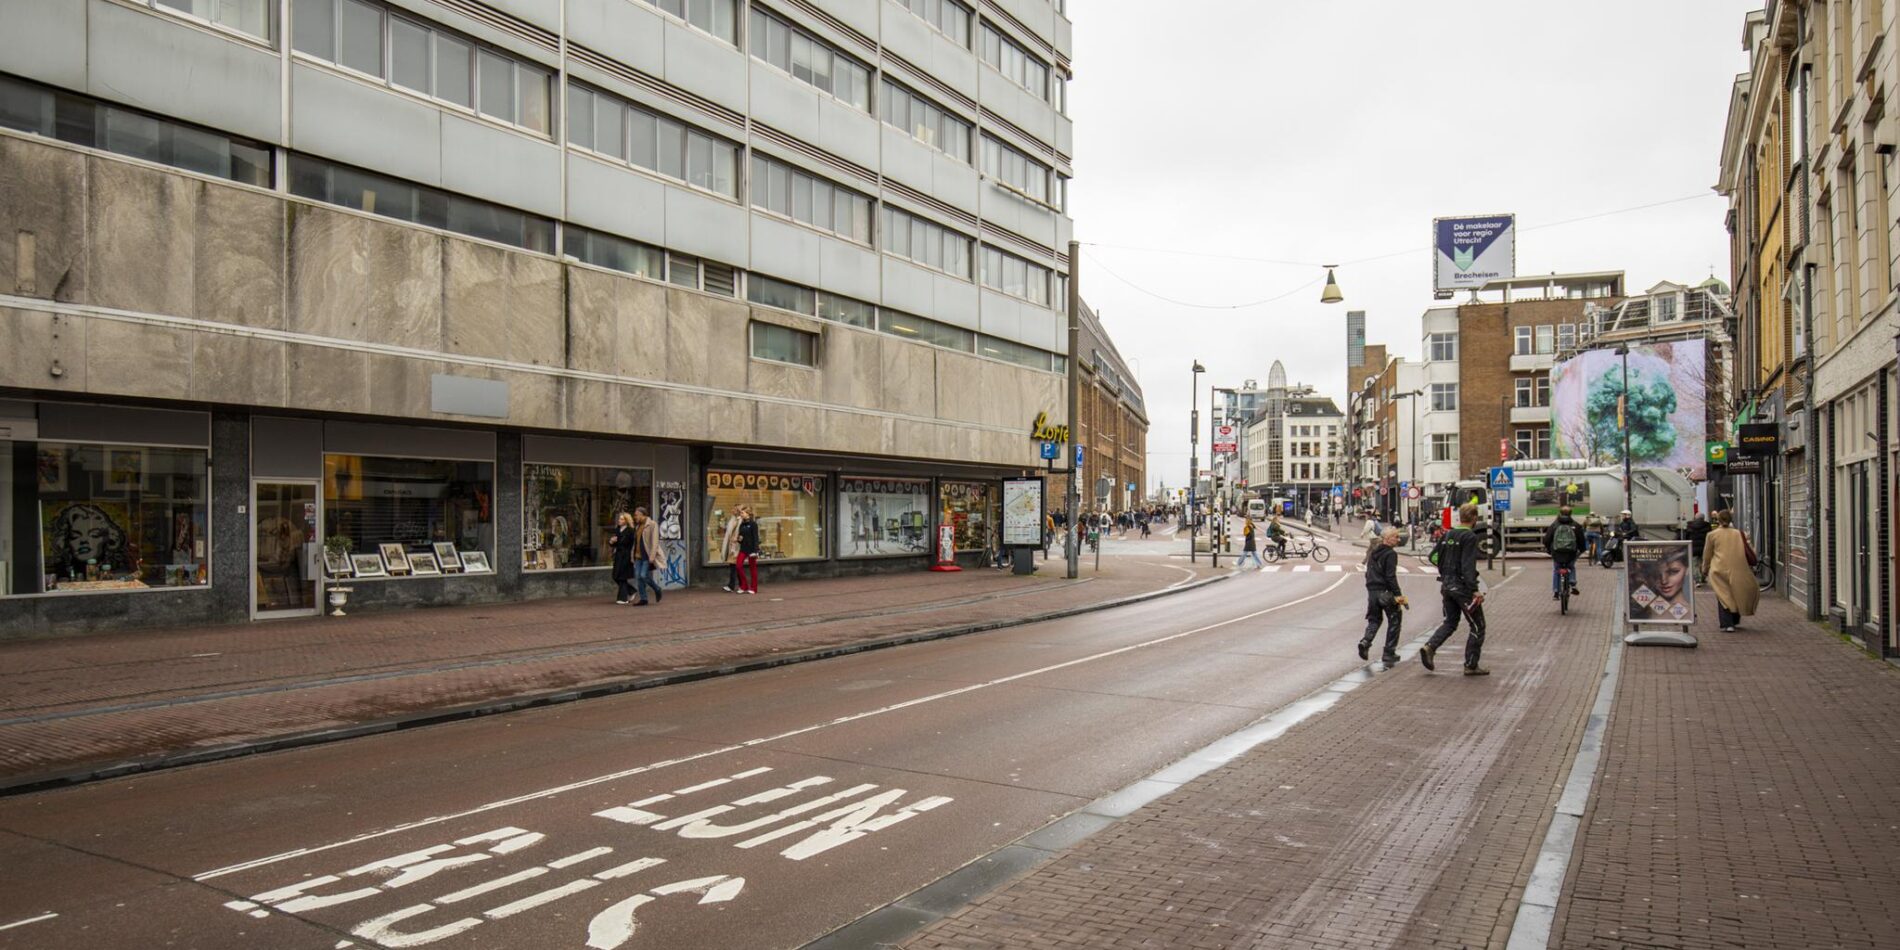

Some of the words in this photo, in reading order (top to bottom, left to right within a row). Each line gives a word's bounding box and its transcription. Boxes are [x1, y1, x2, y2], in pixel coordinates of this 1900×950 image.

[1466, 222, 1502, 230] makelaar
[1472, 229, 1493, 238] regio
[1044, 443, 1051, 453] P
